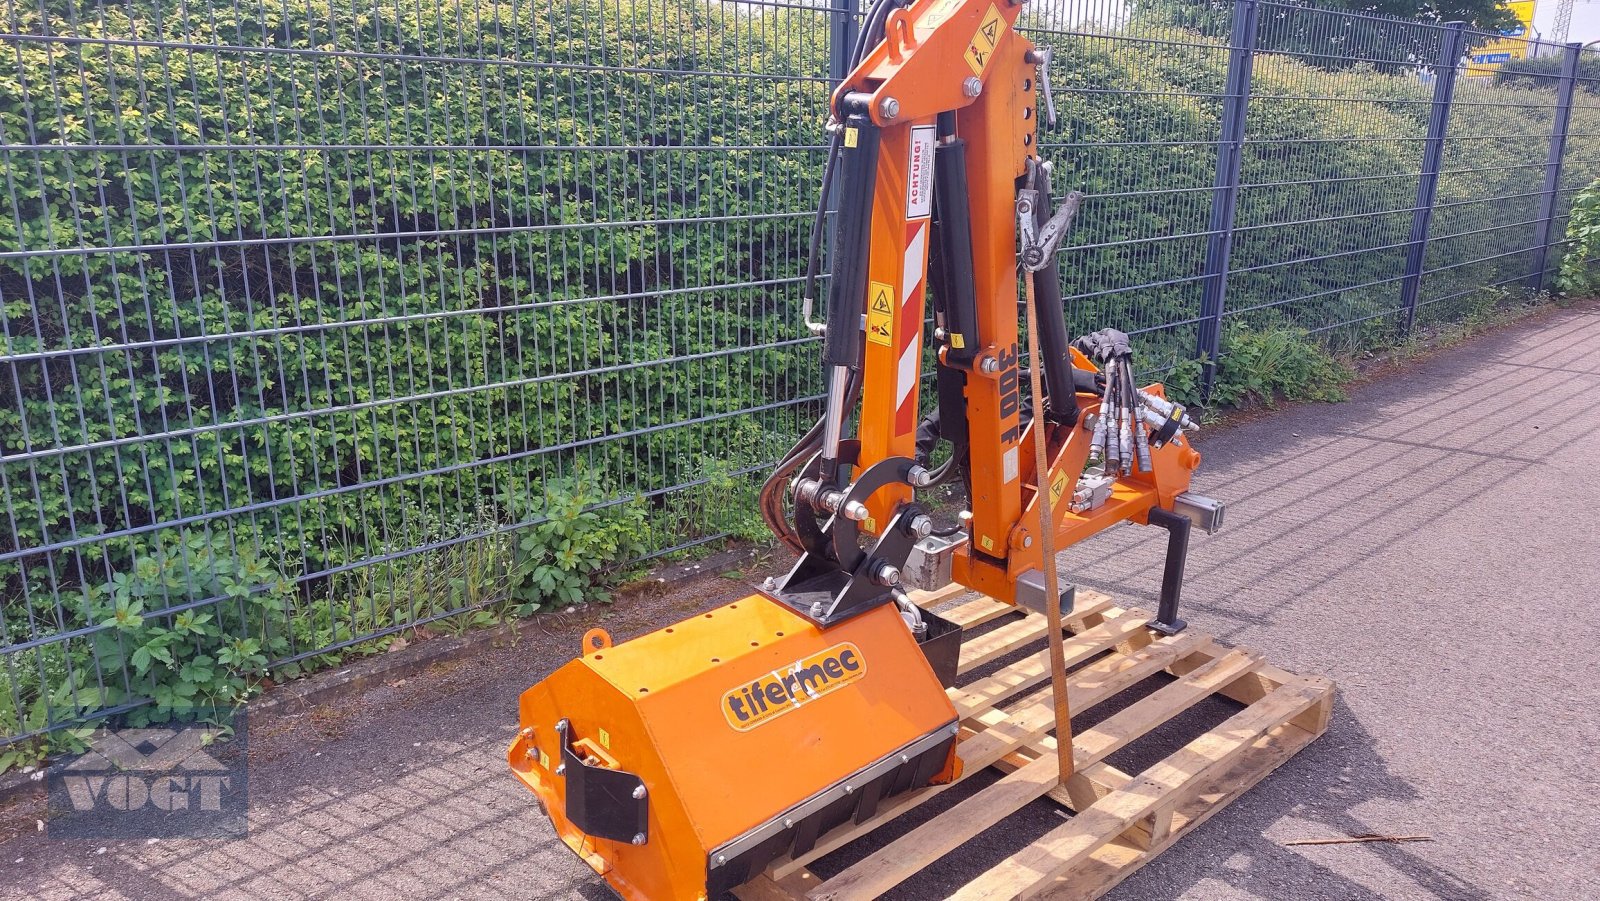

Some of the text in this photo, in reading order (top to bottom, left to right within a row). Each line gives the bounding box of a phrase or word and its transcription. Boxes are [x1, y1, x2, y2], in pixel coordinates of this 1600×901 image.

[911, 141, 921, 205] ACHTUNG!
[999, 342, 1018, 420] 300
[1001, 424, 1018, 445] F
[728, 650, 860, 721] tifermec
